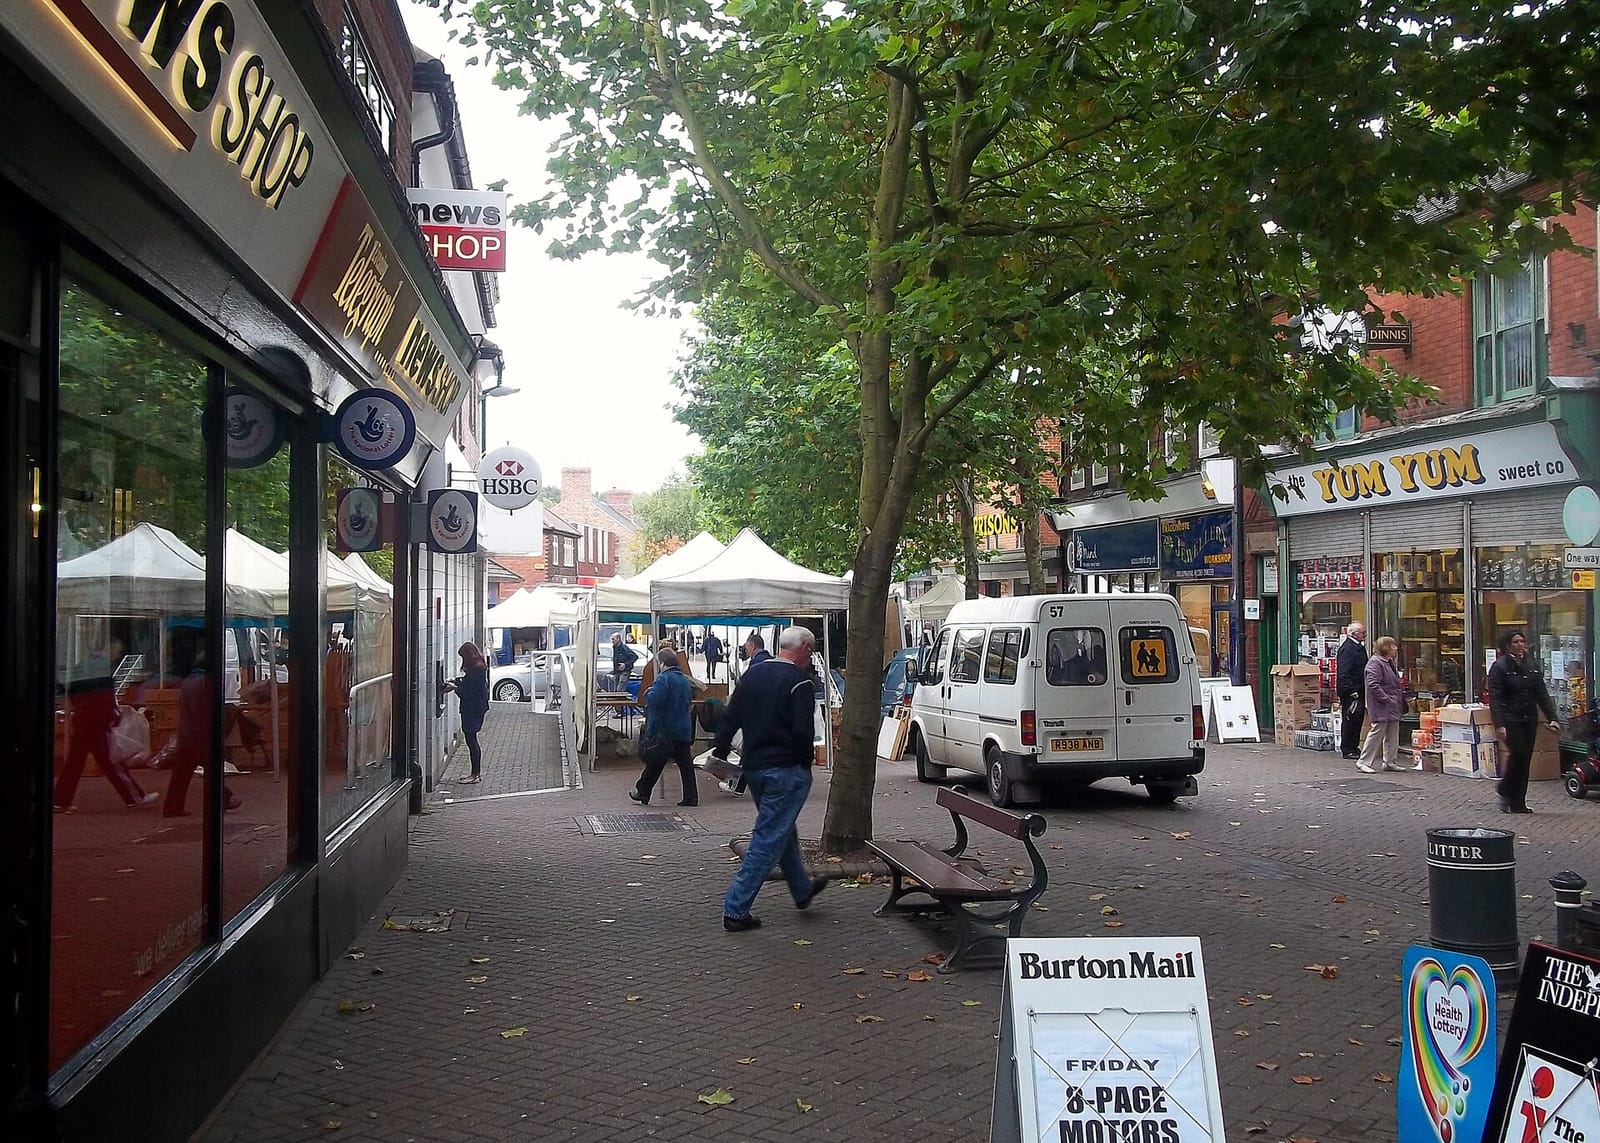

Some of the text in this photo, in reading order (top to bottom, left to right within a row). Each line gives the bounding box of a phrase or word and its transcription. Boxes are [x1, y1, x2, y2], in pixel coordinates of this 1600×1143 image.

[211, 50, 315, 211] SHOP
[410, 202, 501, 226] news
[423, 233, 501, 260] HOP
[332, 223, 404, 352] Telegraph
[1369, 331, 1408, 341] DINNIS
[352, 438, 381, 453] National
[1288, 442, 1566, 504] the YUM YUM sweet co
[481, 477, 538, 496] HSBC
[1203, 553, 1232, 565] WORKSHOP
[1566, 552, 1600, 565] One way
[1050, 606, 1064, 618] 57
[1055, 740, 1100, 750] R938 ANB
[1428, 842, 1483, 860] LITTER
[1545, 956, 1585, 987] THE
[1440, 996, 1451, 1005] The
[1434, 1004, 1463, 1023] Health
[1432, 1017, 1464, 1041] Lottery
[1066, 1059, 1160, 1072] FRIDAY
[1066, 1085, 1167, 1114] 8-PAGE
[1059, 1119, 1180, 1143] MOTORS
[1554, 1116, 1585, 1143] The
